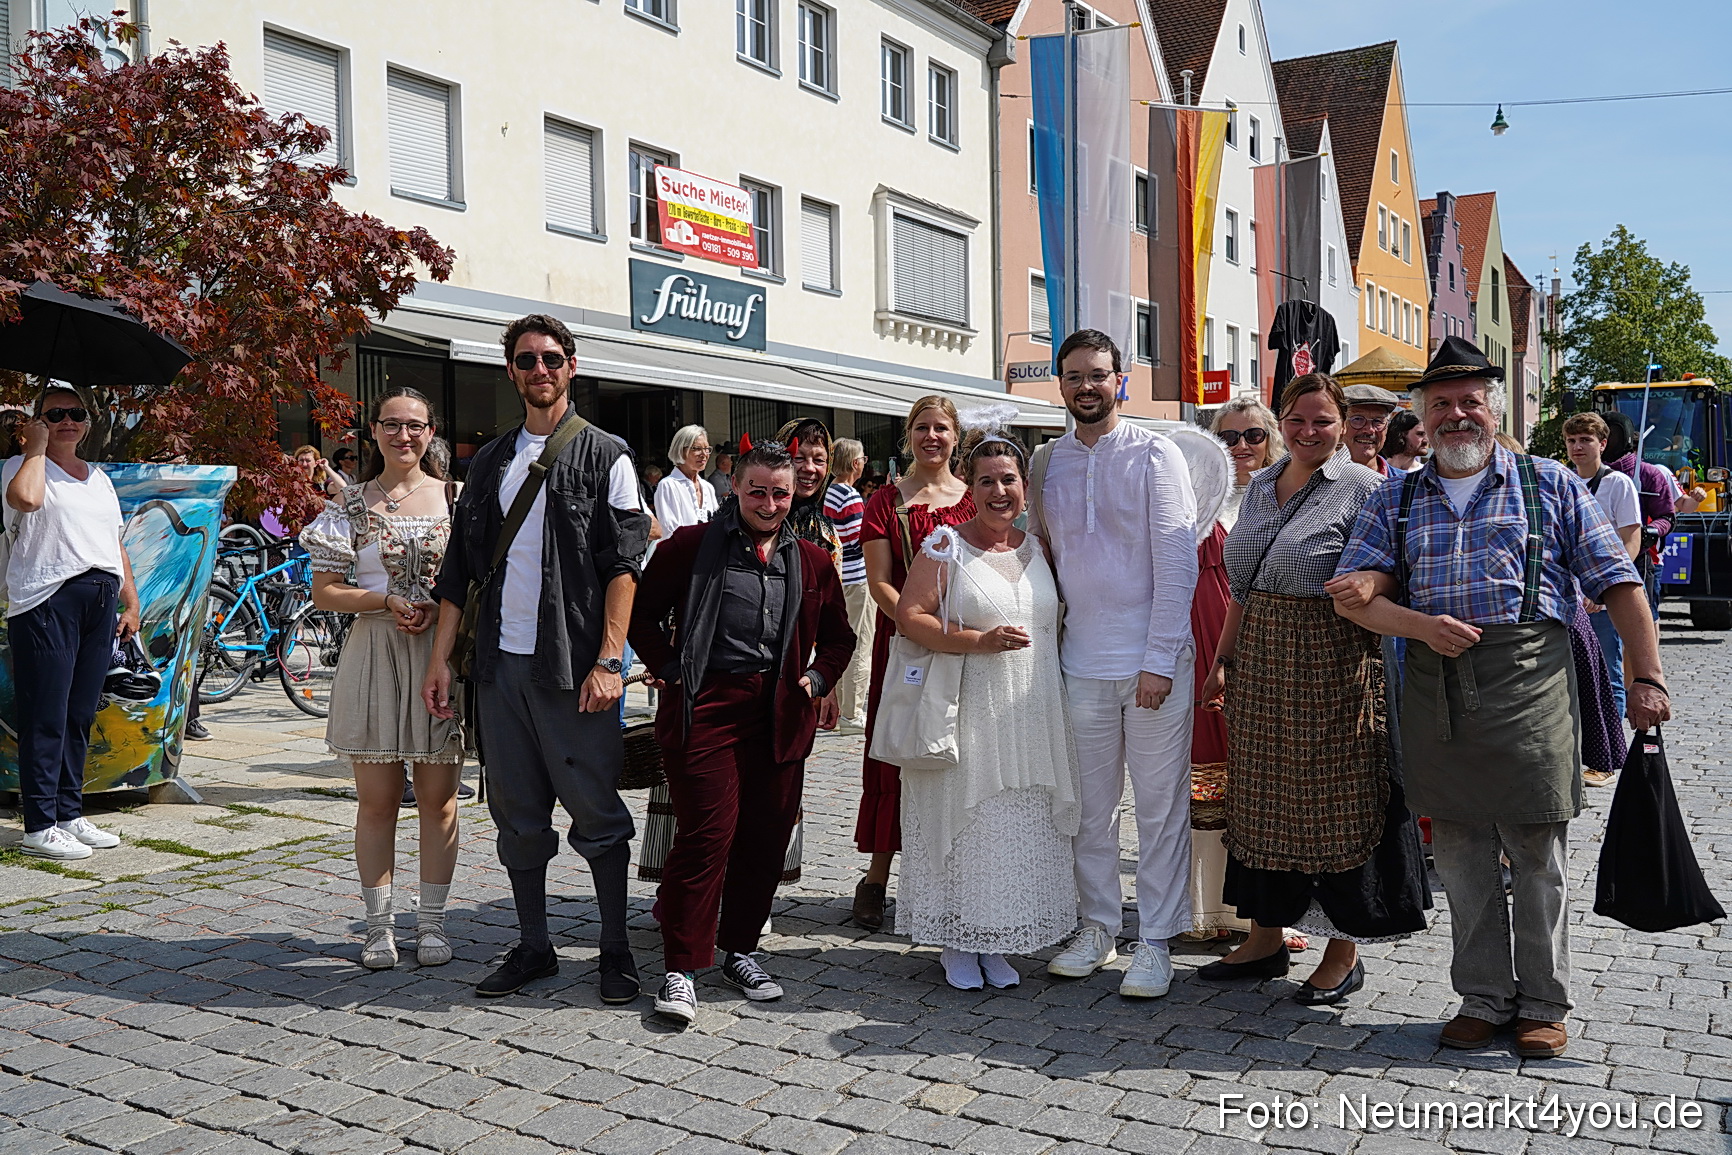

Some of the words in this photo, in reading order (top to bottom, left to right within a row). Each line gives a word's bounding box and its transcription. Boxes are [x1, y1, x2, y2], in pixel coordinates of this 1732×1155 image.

[661, 176, 706, 201] Suche
[709, 188, 749, 215] Mieter!
[702, 241, 721, 254] 09181
[727, 247, 740, 258] 509
[742, 251, 754, 262] 390
